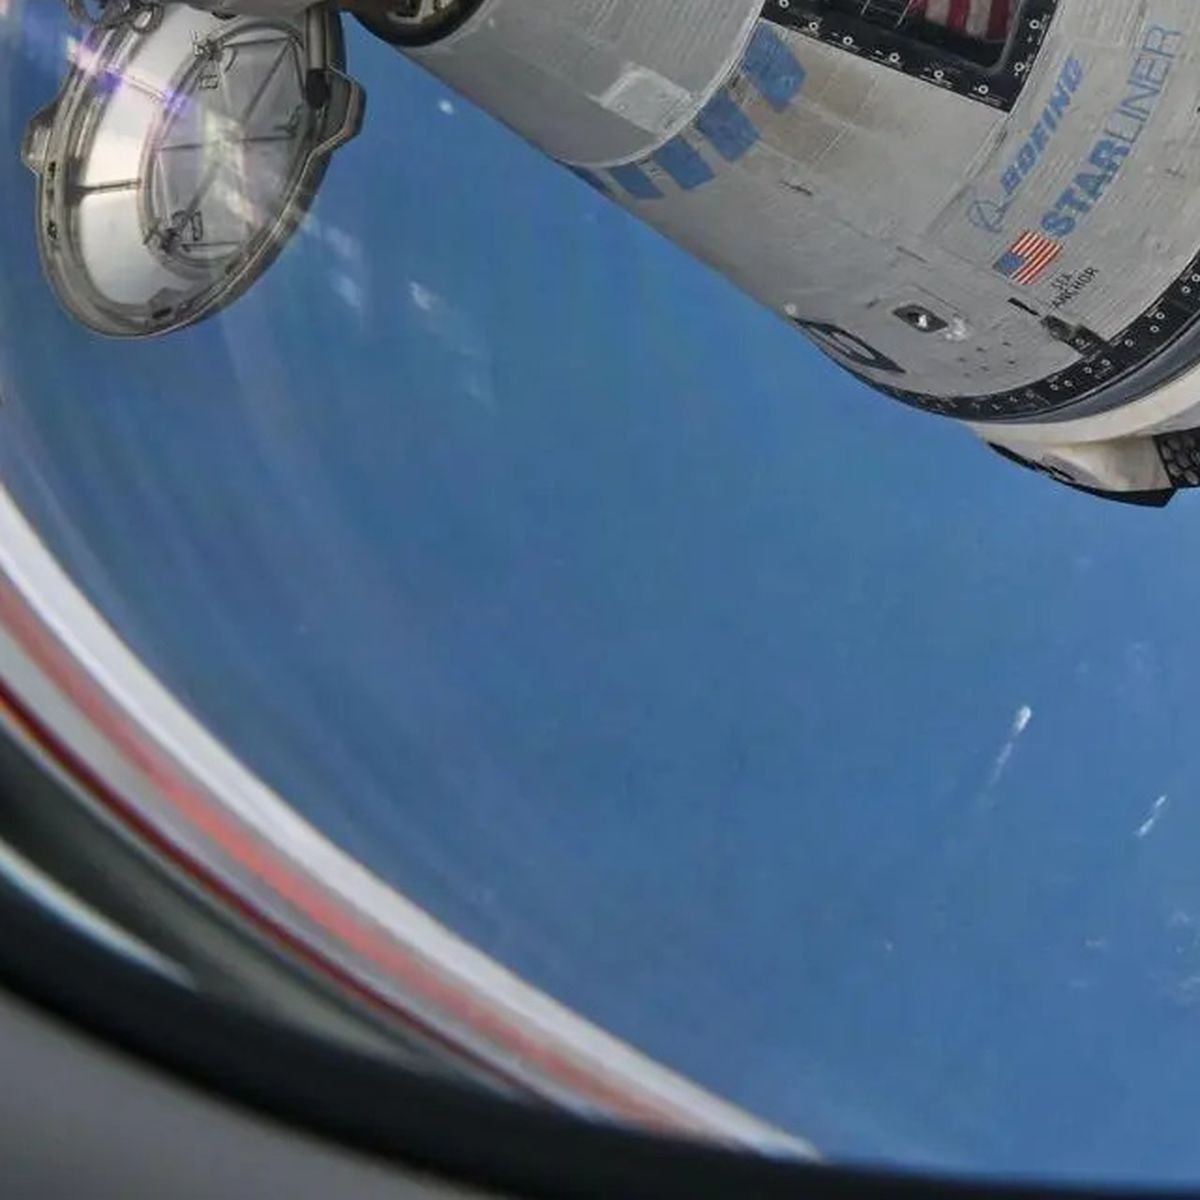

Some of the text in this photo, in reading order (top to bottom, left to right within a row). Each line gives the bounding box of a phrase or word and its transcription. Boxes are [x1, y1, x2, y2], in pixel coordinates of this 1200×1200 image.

[1001, 56, 1083, 195] BOEING
[1041, 26, 1182, 237] STARLINER
[1049, 267, 1099, 311] ANCHOR
